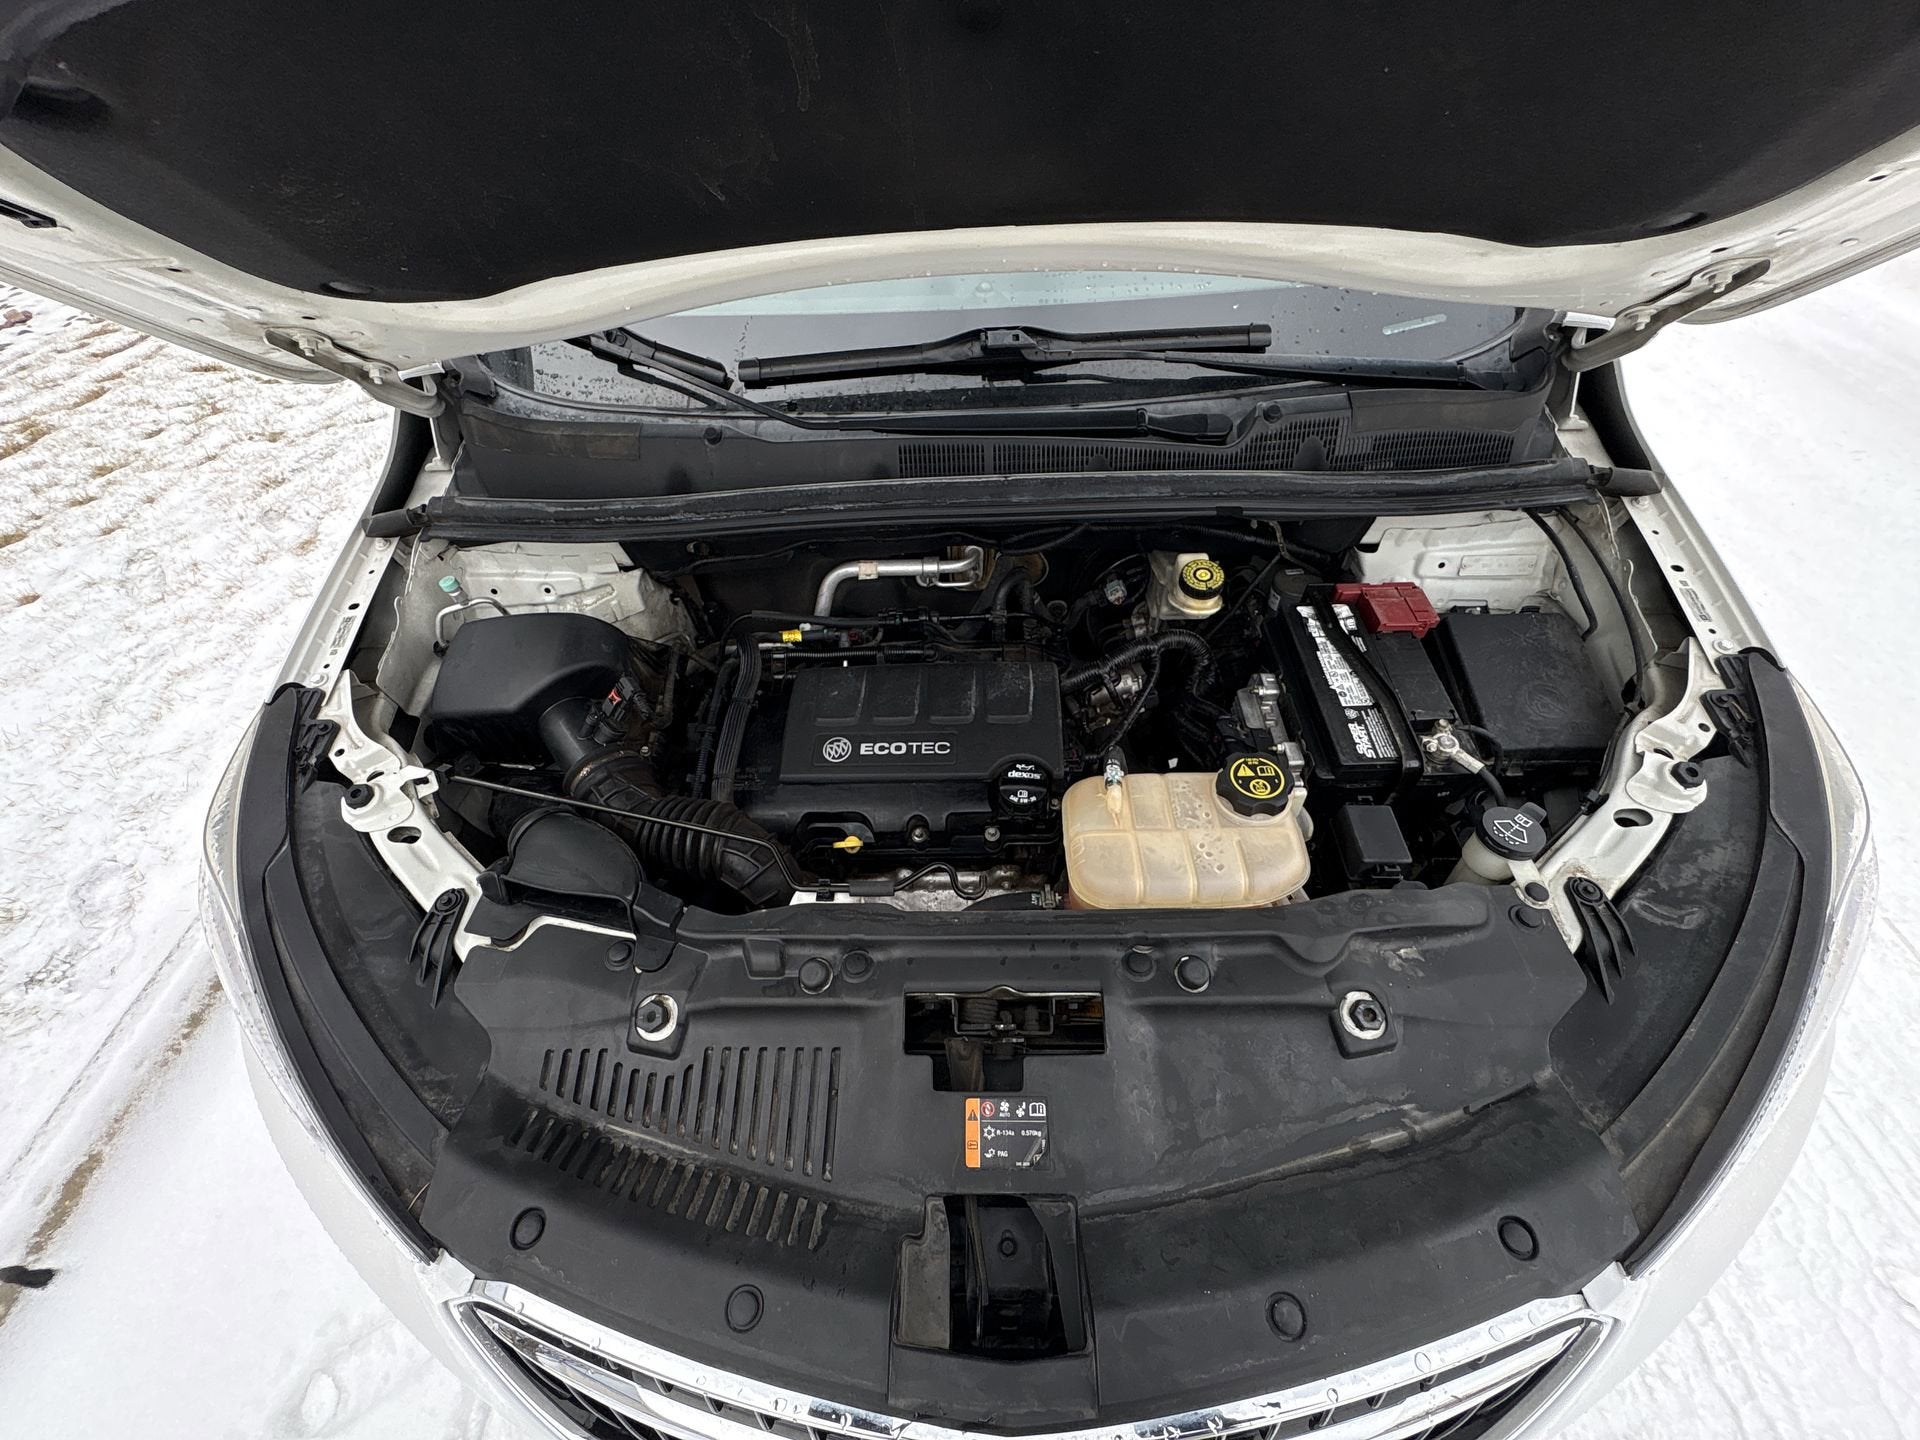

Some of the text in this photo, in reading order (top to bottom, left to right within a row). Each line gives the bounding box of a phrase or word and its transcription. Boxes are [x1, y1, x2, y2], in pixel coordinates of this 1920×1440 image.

[860, 742, 951, 755] ECOTEC
[1007, 770, 1041, 779] dexos
[1021, 1129, 1041, 1137] 0.570kg
[997, 1150, 1009, 1158] PAG
